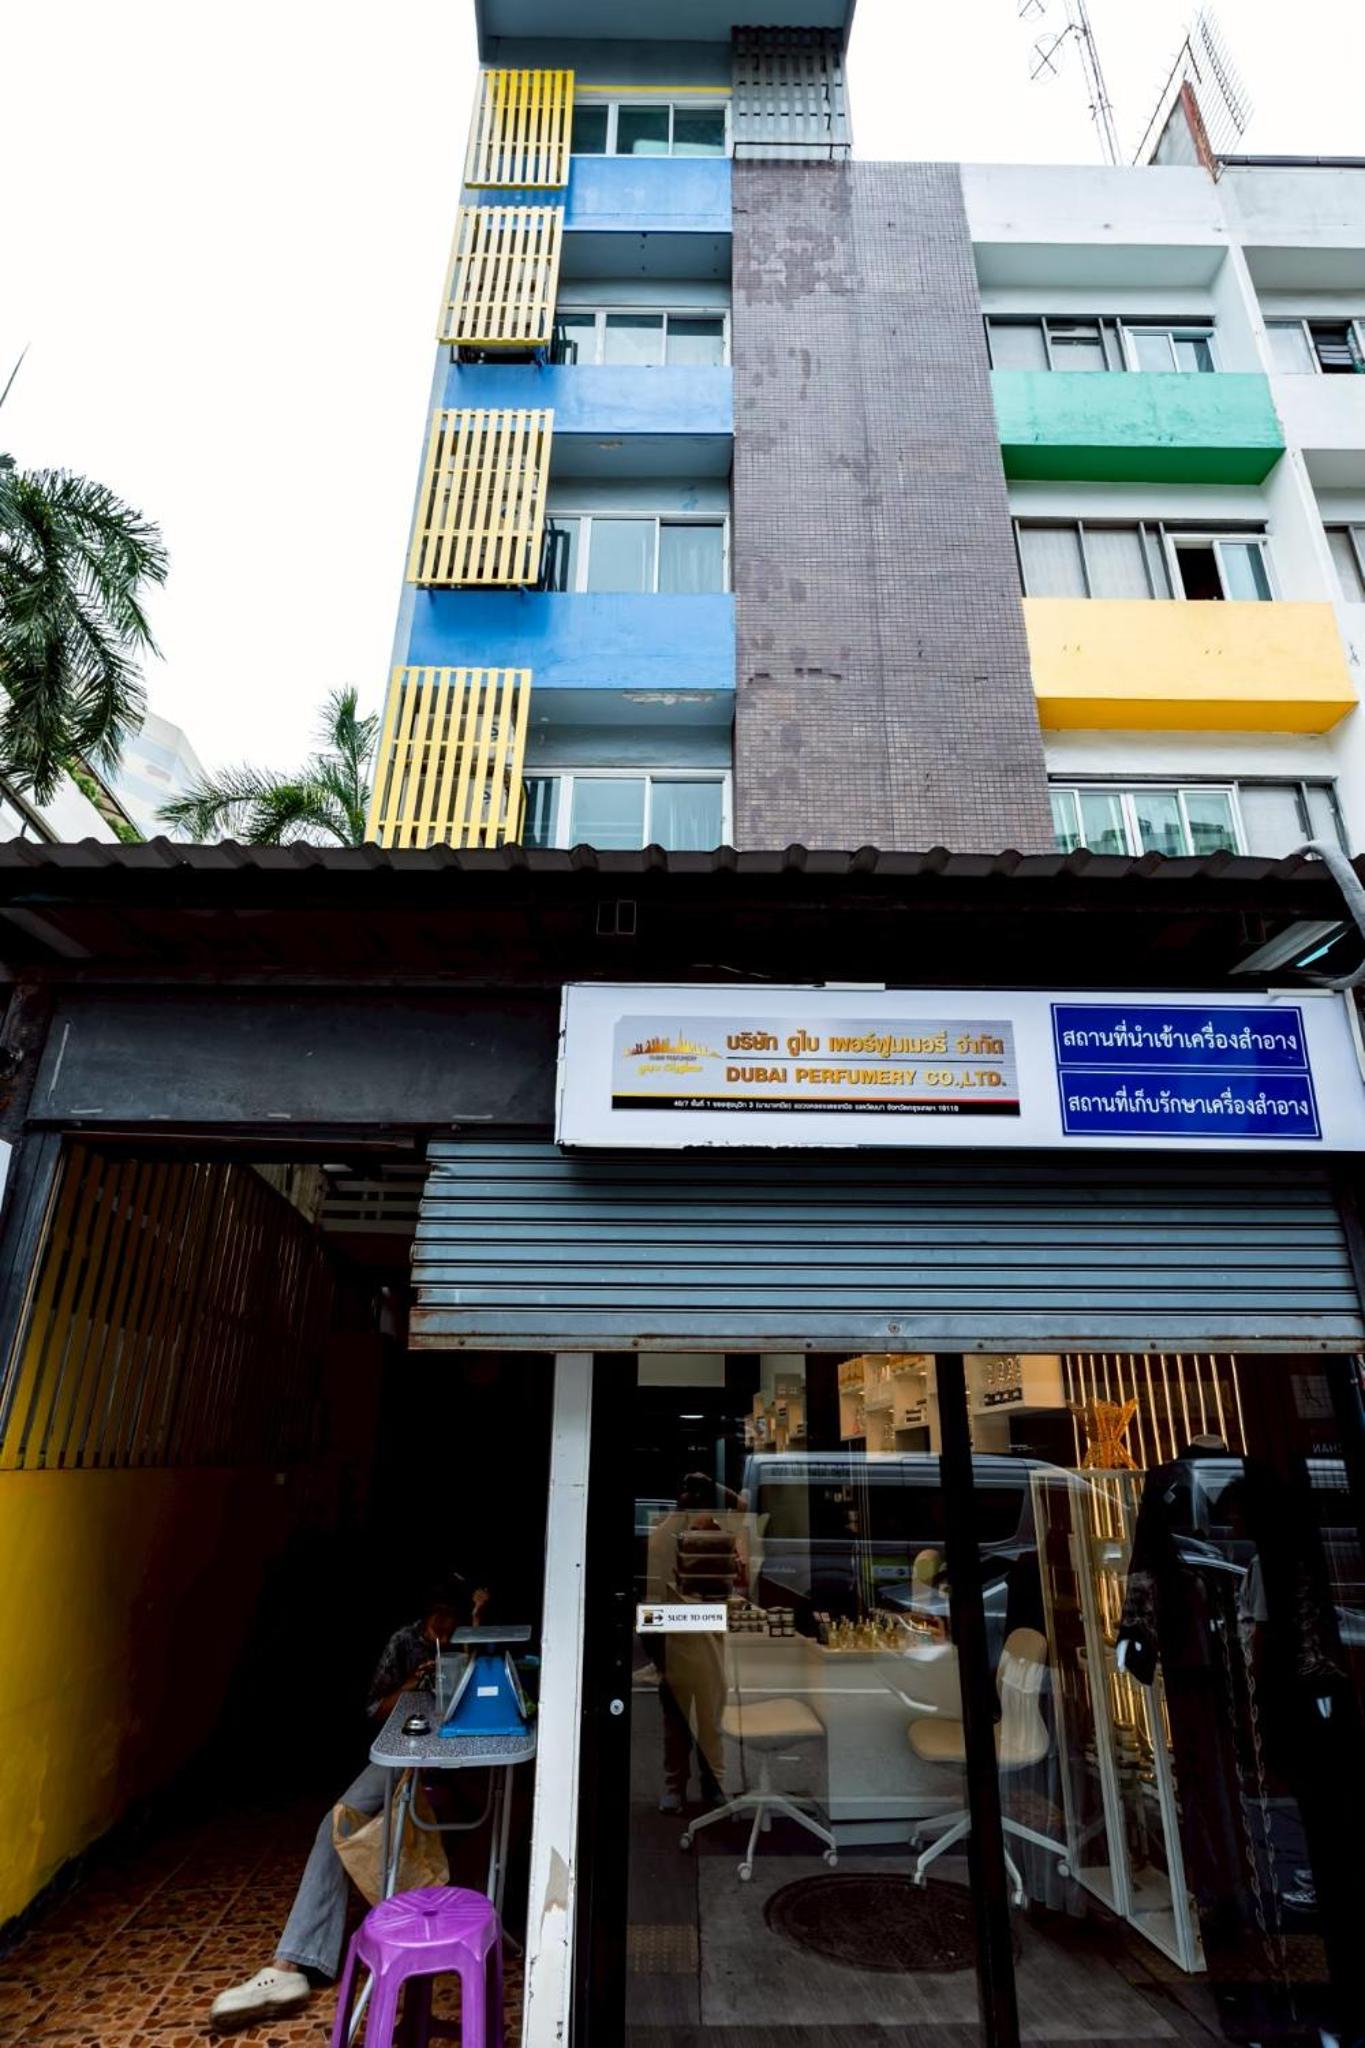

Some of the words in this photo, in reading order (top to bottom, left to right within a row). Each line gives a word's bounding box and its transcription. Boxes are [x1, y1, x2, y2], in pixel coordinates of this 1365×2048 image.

[727, 1031, 778, 1051] บริษัท
[787, 1029, 820, 1057] ดูไบ
[956, 1033, 1005, 1055] จำกัด
[1062, 1019, 1298, 1050] สถานที่นำเข้าเครื่องสำอาง
[726, 1066, 787, 1084] DUBAI
[796, 1068, 917, 1086] PERFUMERY
[926, 1070, 1008, 1089] CO.,LTD.
[1068, 1085, 1309, 1116] สถานที่เก็บรักษาเครื่องสำอาง
[667, 1614, 688, 1622] SLIDE
[690, 1614, 700, 1622] TO
[702, 1614, 723, 1622] OPEN
